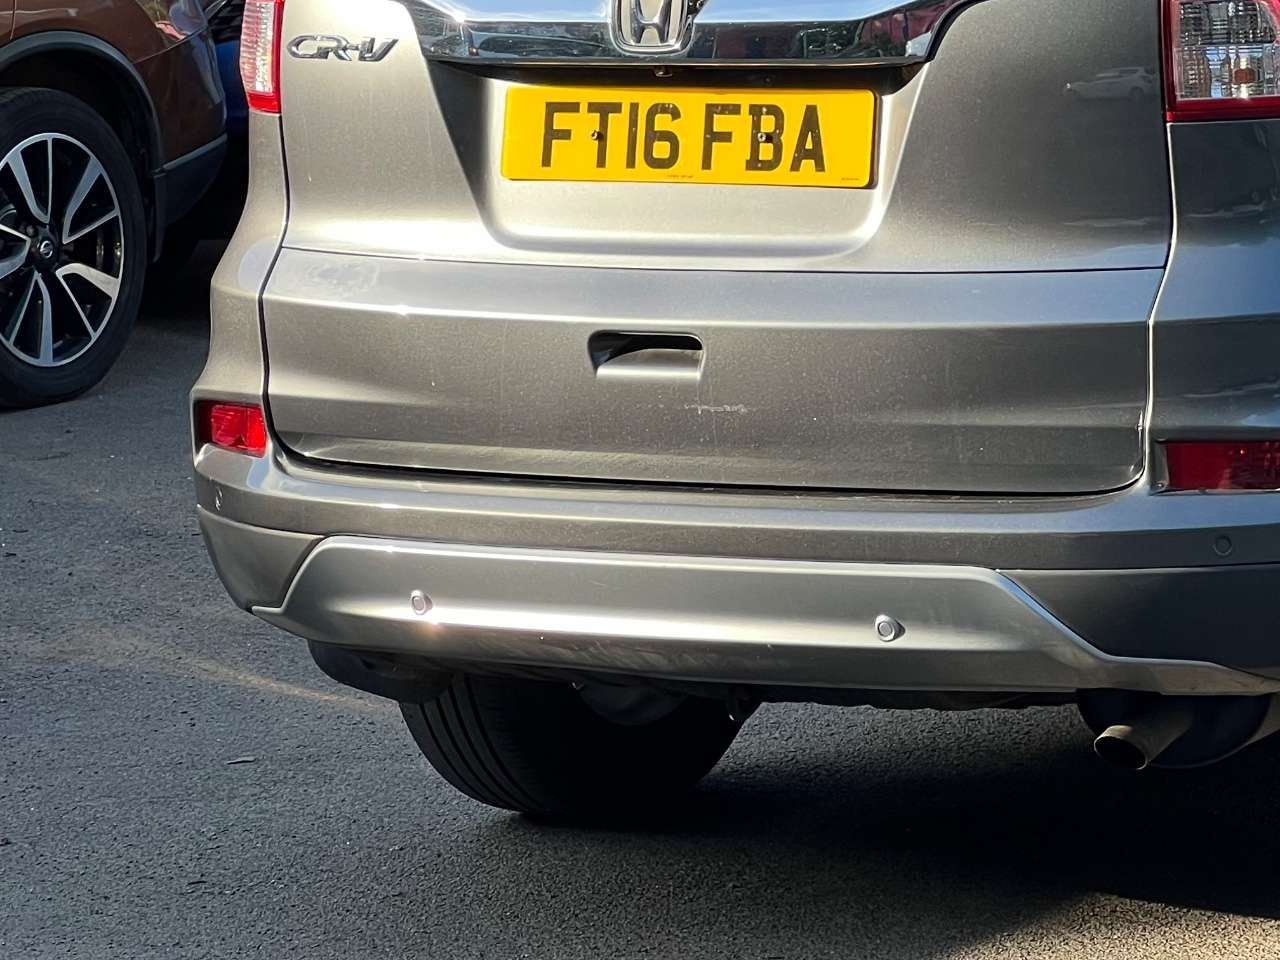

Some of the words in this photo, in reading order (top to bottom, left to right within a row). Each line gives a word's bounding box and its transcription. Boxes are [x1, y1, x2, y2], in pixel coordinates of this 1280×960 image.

[287, 34, 399, 62] CR-V
[541, 101, 682, 170] FT16
[701, 103, 826, 173] FBA
